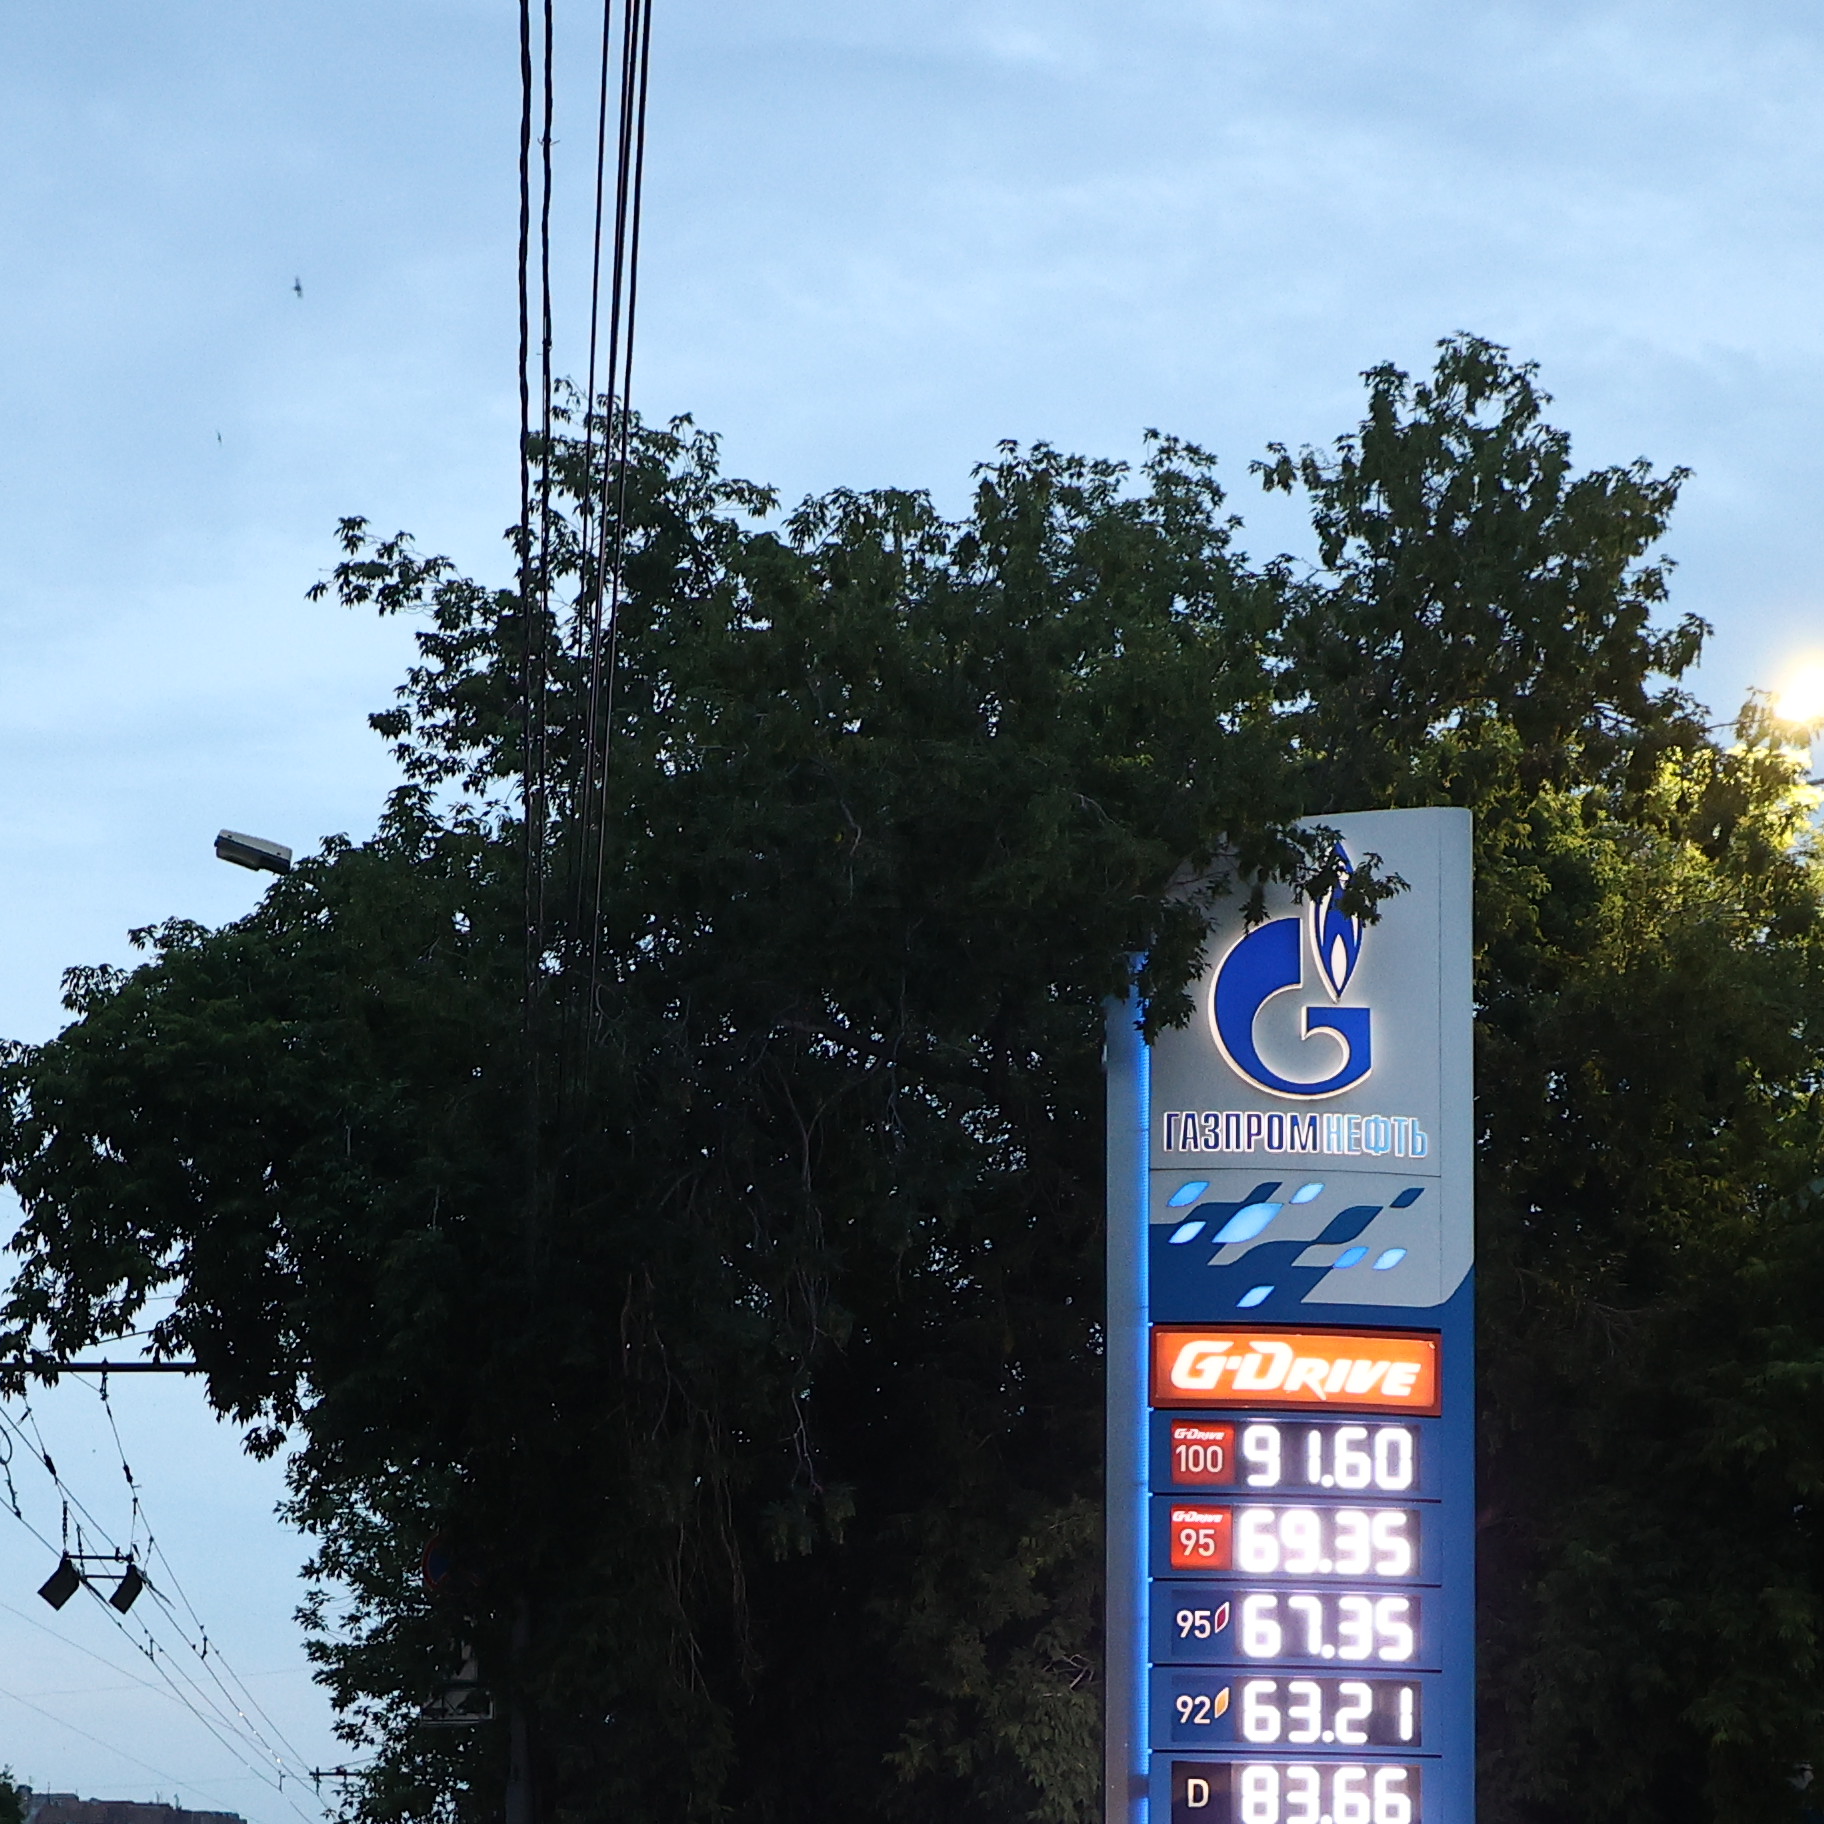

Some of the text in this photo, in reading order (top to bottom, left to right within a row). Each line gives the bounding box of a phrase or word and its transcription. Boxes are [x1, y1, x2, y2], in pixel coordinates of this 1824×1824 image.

[1176, 1444, 1223, 1472] 100
[1242, 1424, 1412, 1490] 91.60
[1180, 1528, 1215, 1556] 95
[1238, 1509, 1412, 1576] 69.35
[1176, 1594, 1414, 1661] 95 67.35
[1176, 1680, 1413, 1744] 92 63.21
[1187, 1778, 1210, 1808] D
